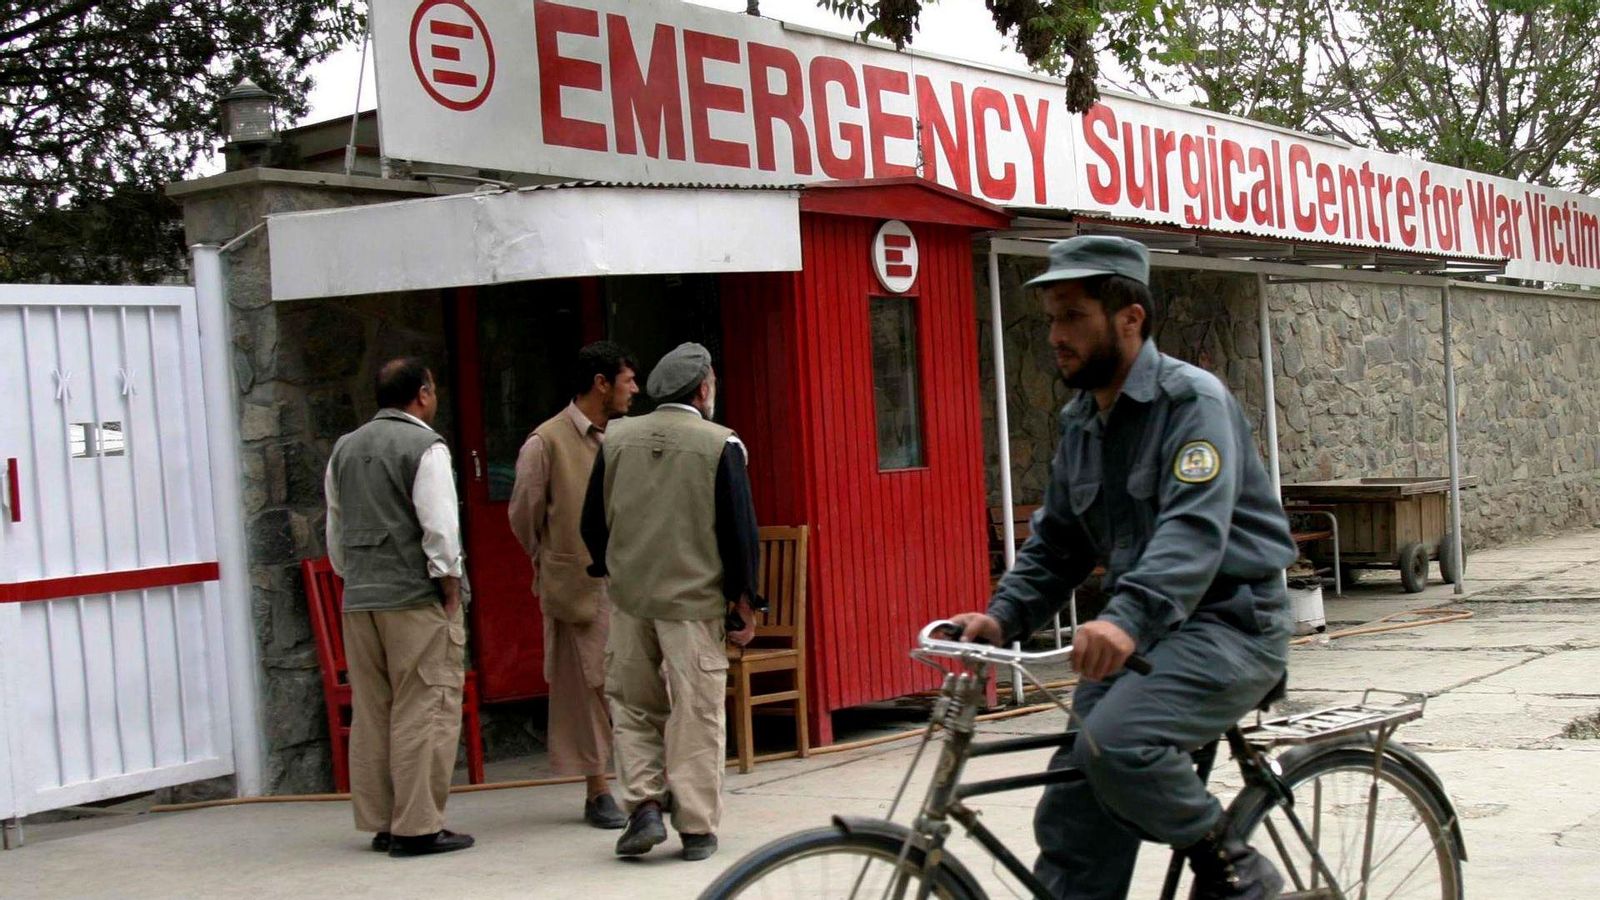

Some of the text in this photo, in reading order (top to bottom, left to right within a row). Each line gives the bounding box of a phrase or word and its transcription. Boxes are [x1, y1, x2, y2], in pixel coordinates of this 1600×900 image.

[535, 0, 1050, 206] EMERGENCY
[1082, 102, 1286, 229] Surgical
[1288, 143, 1417, 247] Centre
[1419, 170, 1463, 252] for
[1466, 178, 1523, 260] War
[885, 234, 912, 277] E
